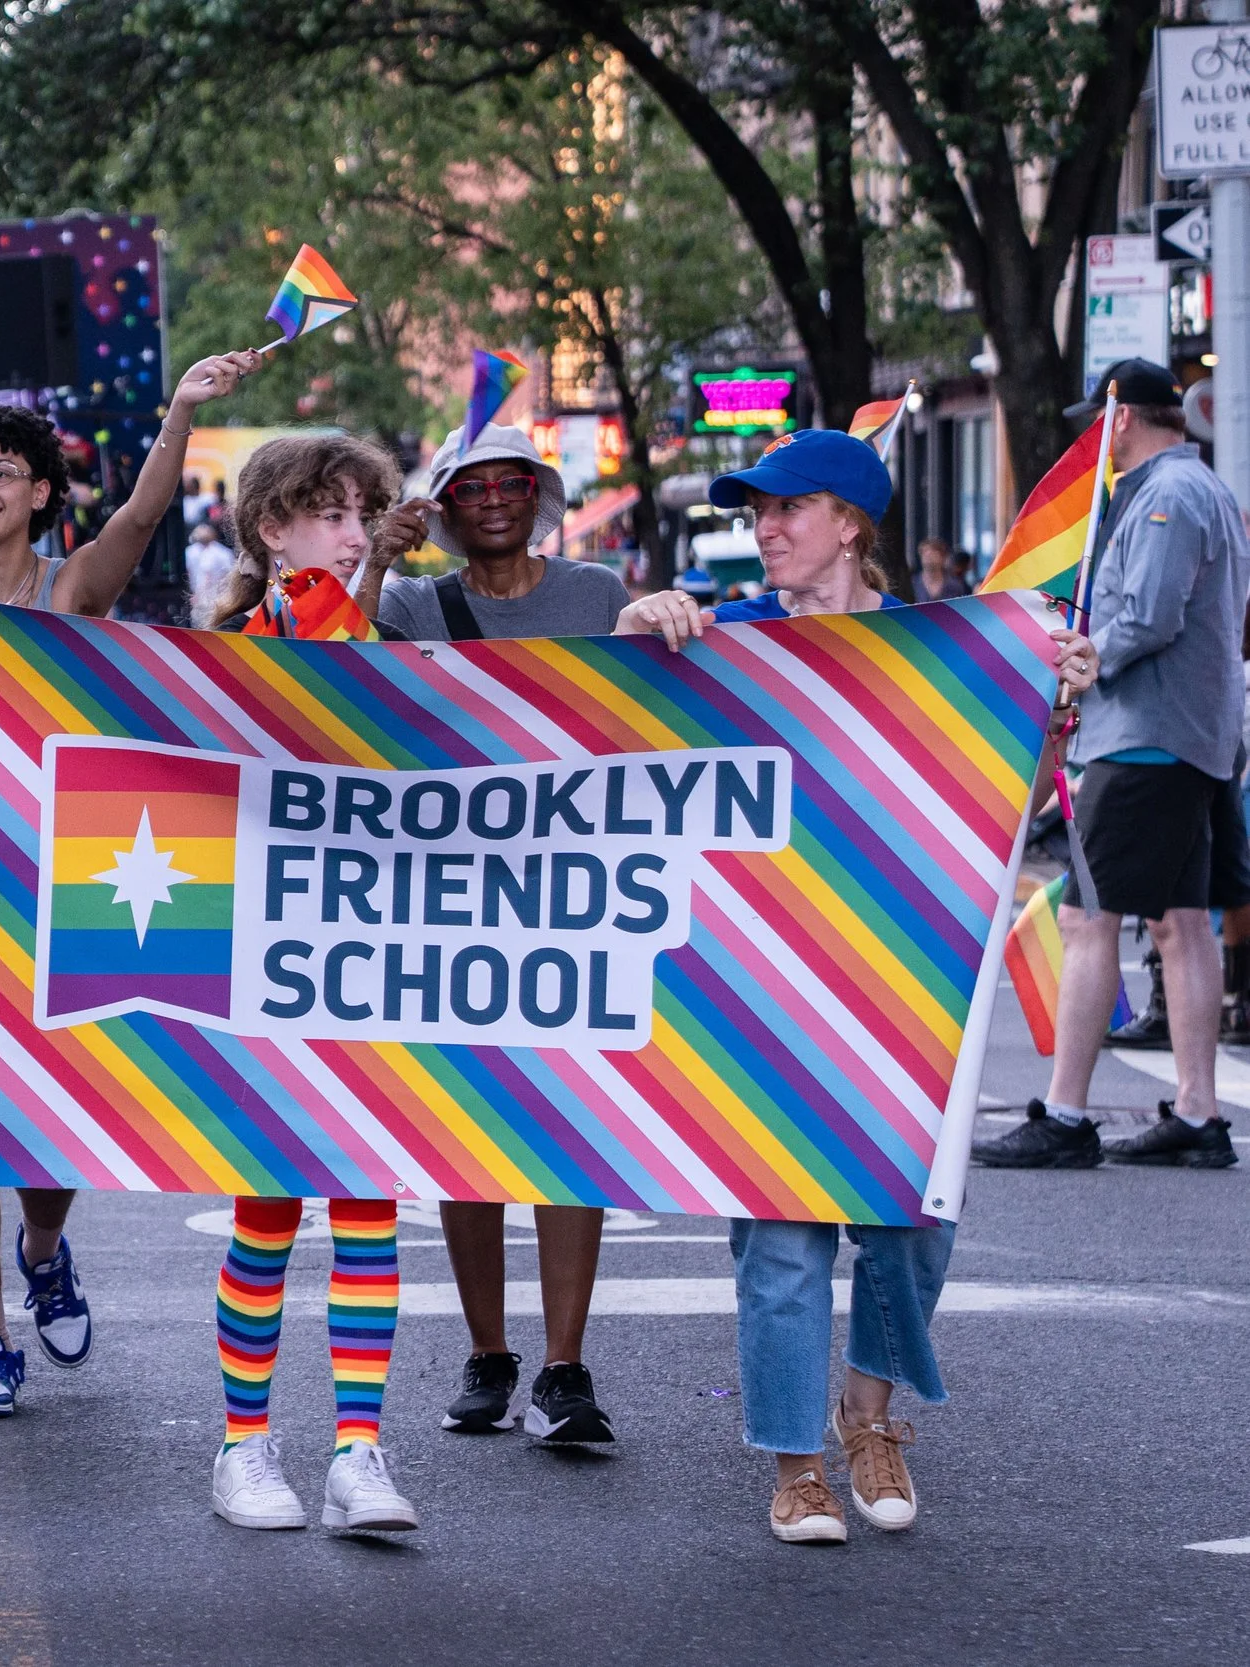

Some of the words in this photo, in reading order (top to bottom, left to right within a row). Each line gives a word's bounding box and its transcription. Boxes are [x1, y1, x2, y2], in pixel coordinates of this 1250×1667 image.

[1174, 142, 1227, 162] FULL
[1195, 112, 1236, 132] USE
[268, 760, 776, 841] BROOKLYN
[264, 844, 670, 935] FRIENDS
[260, 939, 637, 1030] SCHOOL
